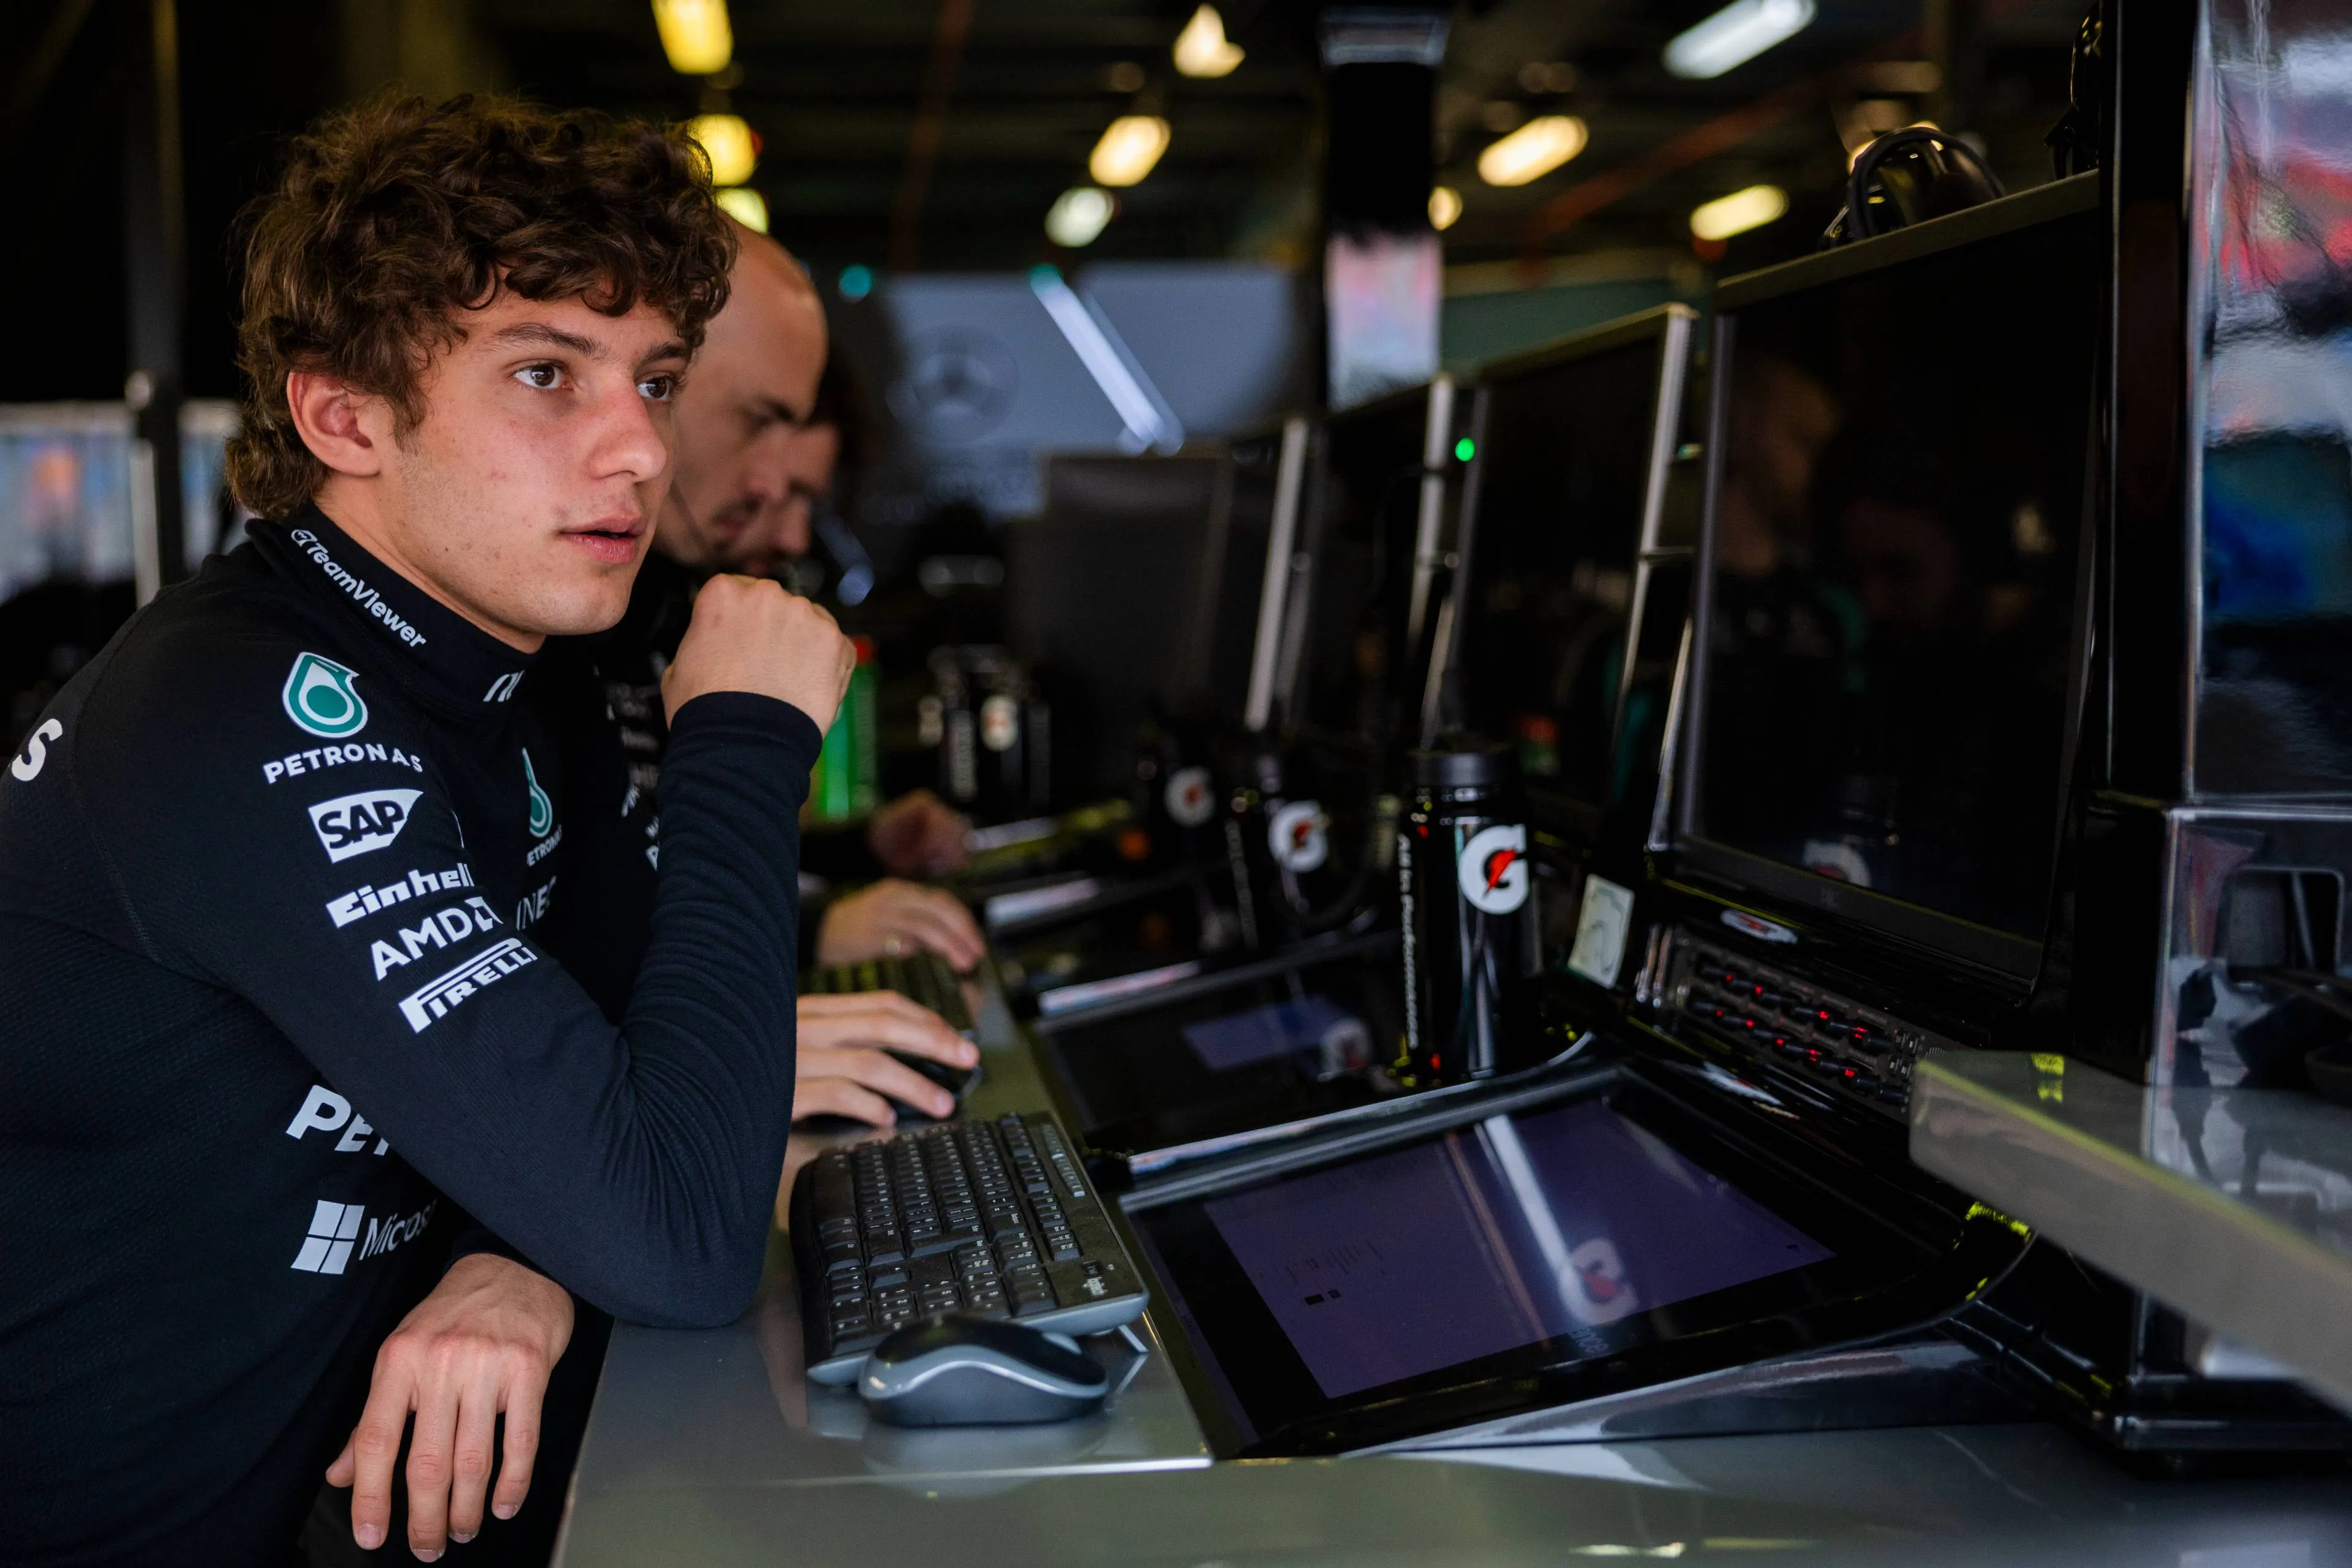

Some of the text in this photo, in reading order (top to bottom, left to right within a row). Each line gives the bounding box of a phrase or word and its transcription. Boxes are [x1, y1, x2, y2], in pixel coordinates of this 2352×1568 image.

[307, 541, 427, 649] TeamViewer
[262, 742, 424, 785] PETRONAS
[318, 799, 405, 849] SAP
[326, 862, 475, 929] Einhell
[1457, 823, 1530, 915] G
[371, 907, 475, 981] AMD
[398, 937, 538, 1034] PIRELLI
